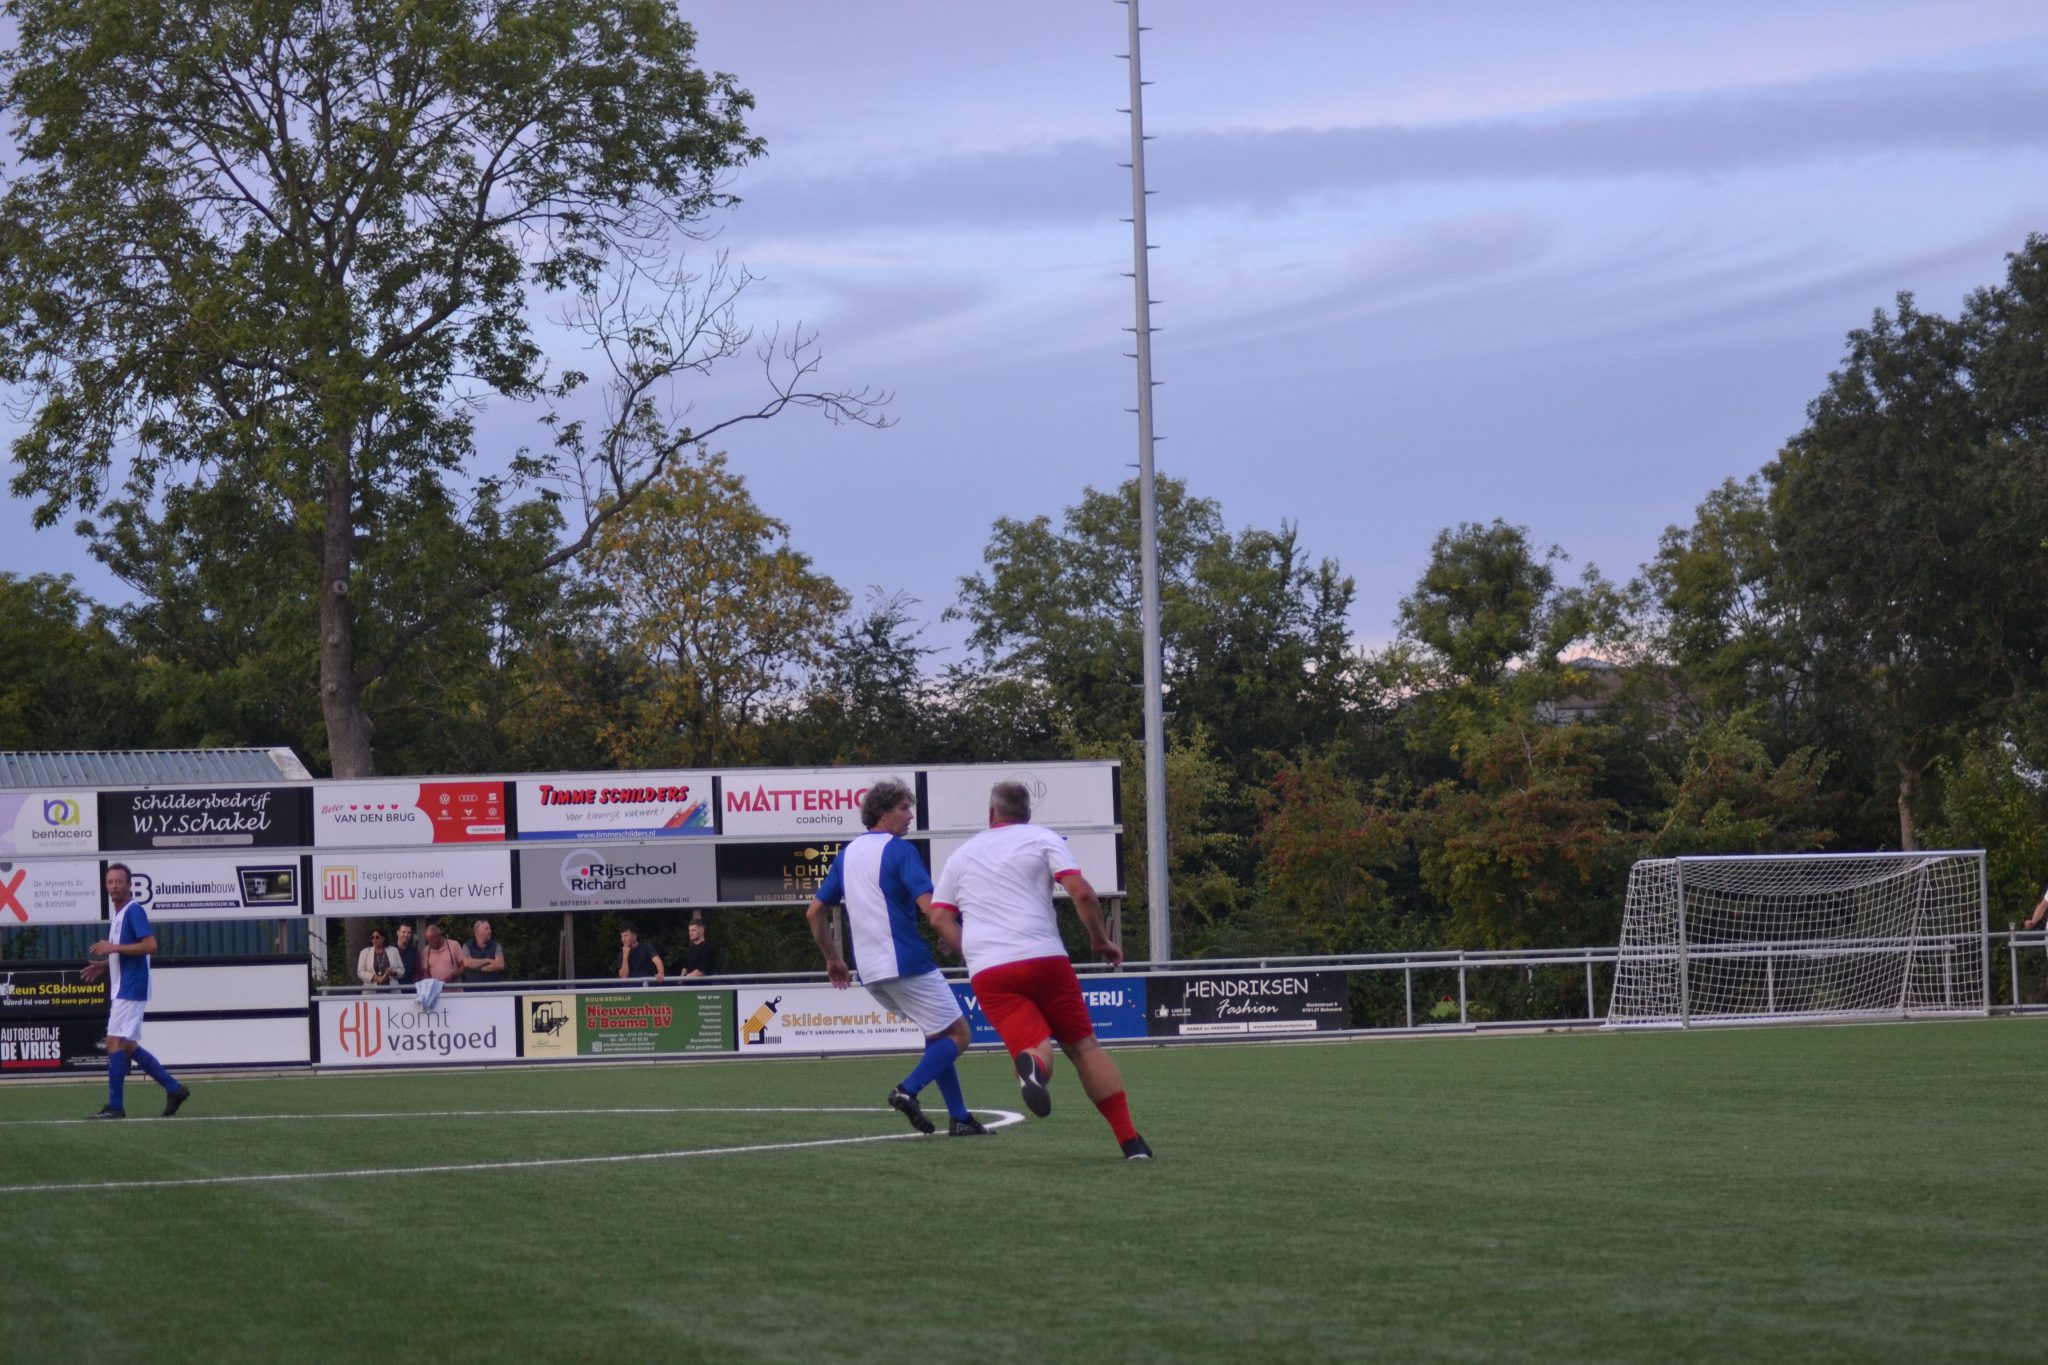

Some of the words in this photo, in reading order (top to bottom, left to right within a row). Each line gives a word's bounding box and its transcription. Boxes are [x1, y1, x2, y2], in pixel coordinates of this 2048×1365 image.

[132, 792, 271, 811] Schildersbedrijf
[539, 784, 597, 806] TIMME
[599, 786, 690, 804] SCHILDERS
[726, 784, 872, 812] MATTERHO
[321, 803, 345, 815] Beter
[566, 813, 583, 821] Voor
[586, 810, 620, 821] kleurrijk
[133, 811, 272, 834] W.Y.Schakel
[334, 814, 357, 823] VAN
[360, 813, 383, 823] DEN
[386, 812, 415, 822] BRUG
[796, 813, 843, 826] coaching
[32, 829, 92, 839] bentacera
[576, 830, 656, 839] www.timmeschilders.nl
[362, 870, 445, 882] Tegelgroothandel
[590, 862, 677, 878] Rijschool
[783, 864, 833, 877] LOHM
[155, 881, 236, 895] aluminiumbouw
[571, 877, 626, 891] Richard
[783, 877, 824, 890] FIET
[65, 889, 96, 897] Bolsward
[362, 885, 405, 900] Julius
[409, 886, 434, 898] van
[439, 884, 463, 898] der
[467, 882, 505, 897] Werf
[604, 897, 690, 906] www.rijschoolrichard.nl
[38, 982, 105, 995] SCBolsward
[1185, 978, 1309, 998] HENDRIKSEN
[586, 1002, 672, 1017] Nieuwenhuis
[1216, 998, 1279, 1019] Fashion
[387, 1006, 450, 1030] komt
[586, 1016, 597, 1029] &
[600, 1016, 648, 1029] Bouma
[653, 1014, 672, 1027] BV
[781, 1011, 882, 1027] Skilderwurk
[1, 1027, 60, 1041] AUTOBEDRIJF
[388, 1025, 497, 1056] vastgoed
[1, 1042, 17, 1060] DE
[20, 1040, 60, 1060] VRIES
